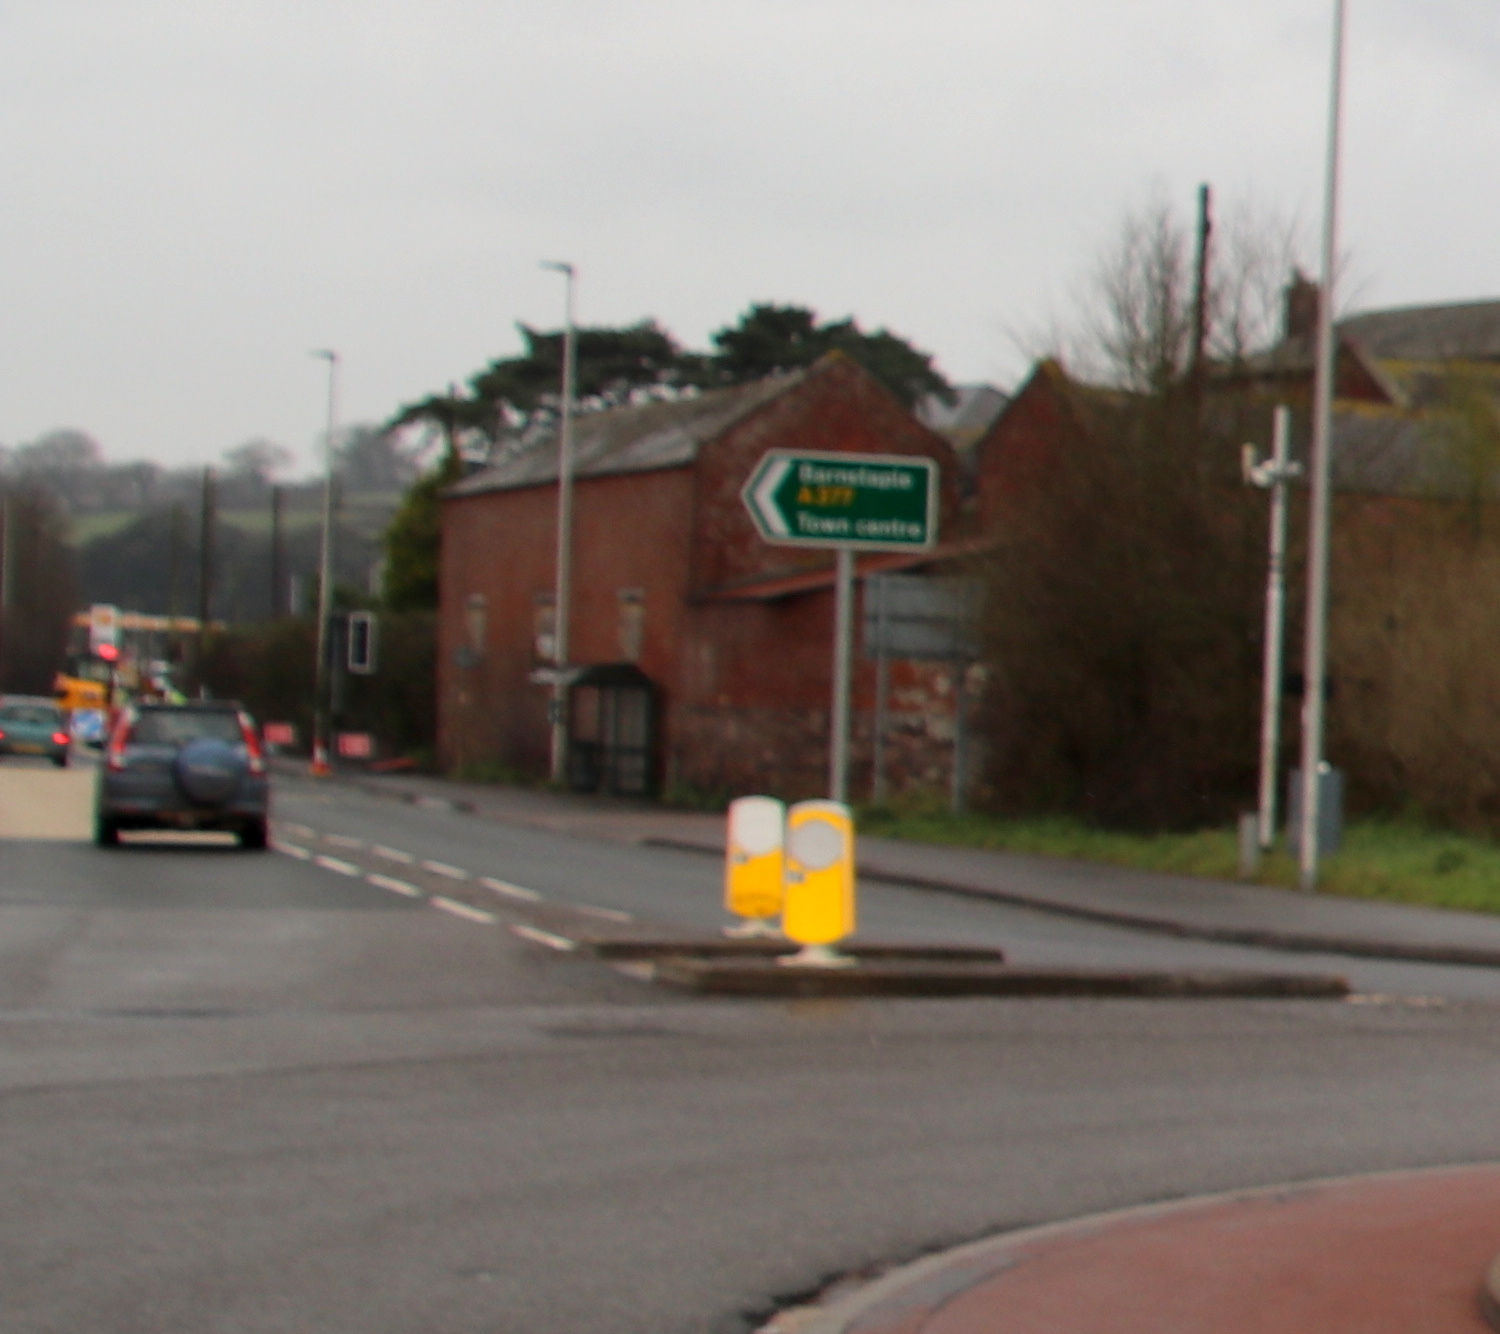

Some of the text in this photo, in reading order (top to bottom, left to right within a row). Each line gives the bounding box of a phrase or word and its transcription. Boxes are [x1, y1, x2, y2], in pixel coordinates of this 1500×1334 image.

[798, 463, 915, 490] Barnstaple
[797, 510, 922, 540] Town centre
